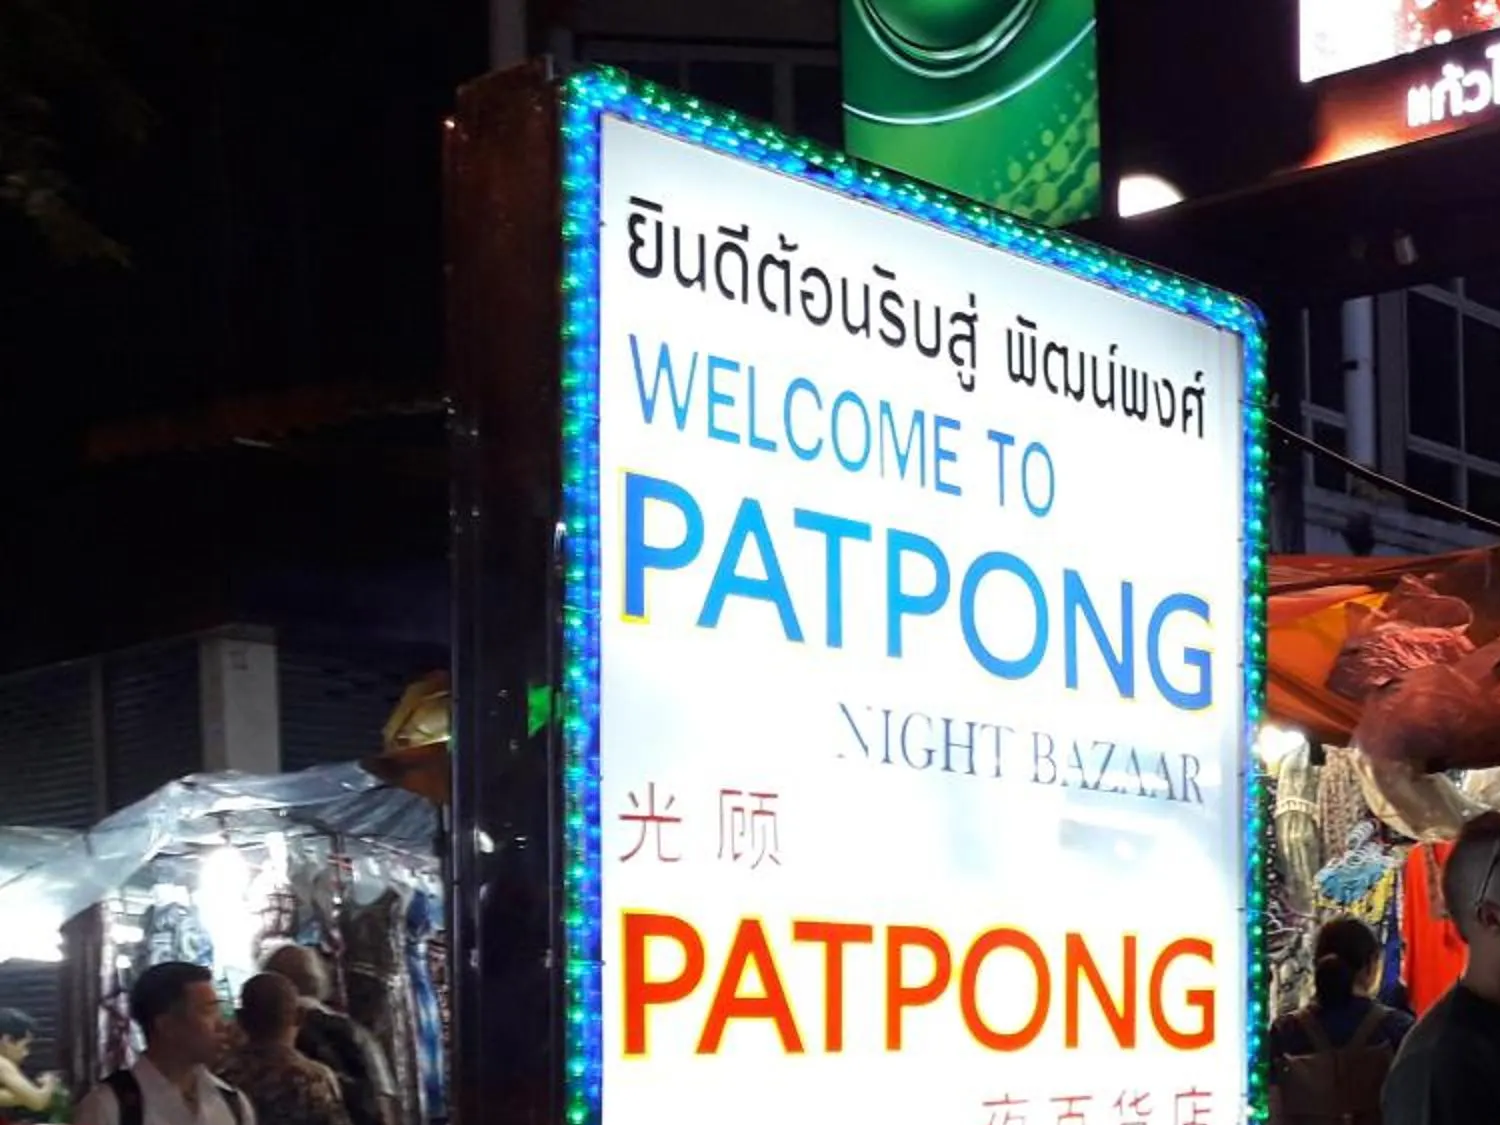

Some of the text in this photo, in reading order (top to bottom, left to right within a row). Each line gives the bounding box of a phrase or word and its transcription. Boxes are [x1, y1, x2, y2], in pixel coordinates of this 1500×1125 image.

[627, 196, 979, 392] ยินดีต้อนรับสู่
[627, 333, 1056, 519] WELCOME TO
[621, 469, 1214, 710] PATPONG
[836, 701, 1205, 806] NIGHT BAZAAR
[620, 911, 1216, 1056] PATPONG
